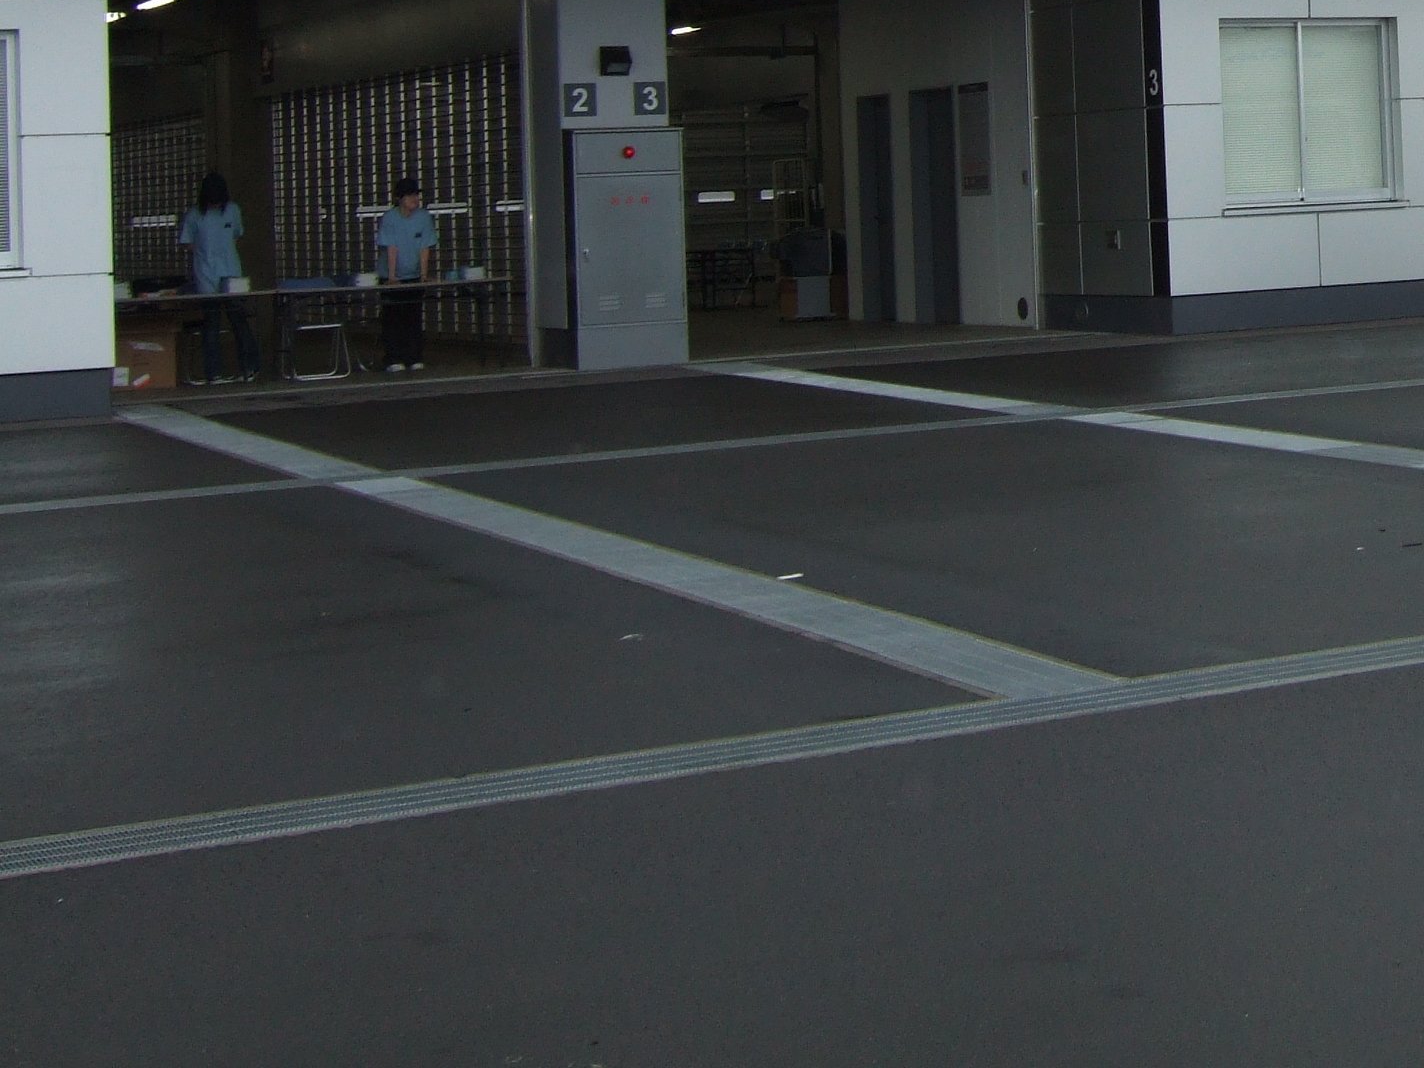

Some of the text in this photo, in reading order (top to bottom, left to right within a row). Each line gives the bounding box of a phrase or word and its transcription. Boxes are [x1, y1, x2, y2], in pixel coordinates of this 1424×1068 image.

[1149, 69, 1159, 96] 3
[572, 87, 589, 112] 2
[642, 86, 659, 111] 3
